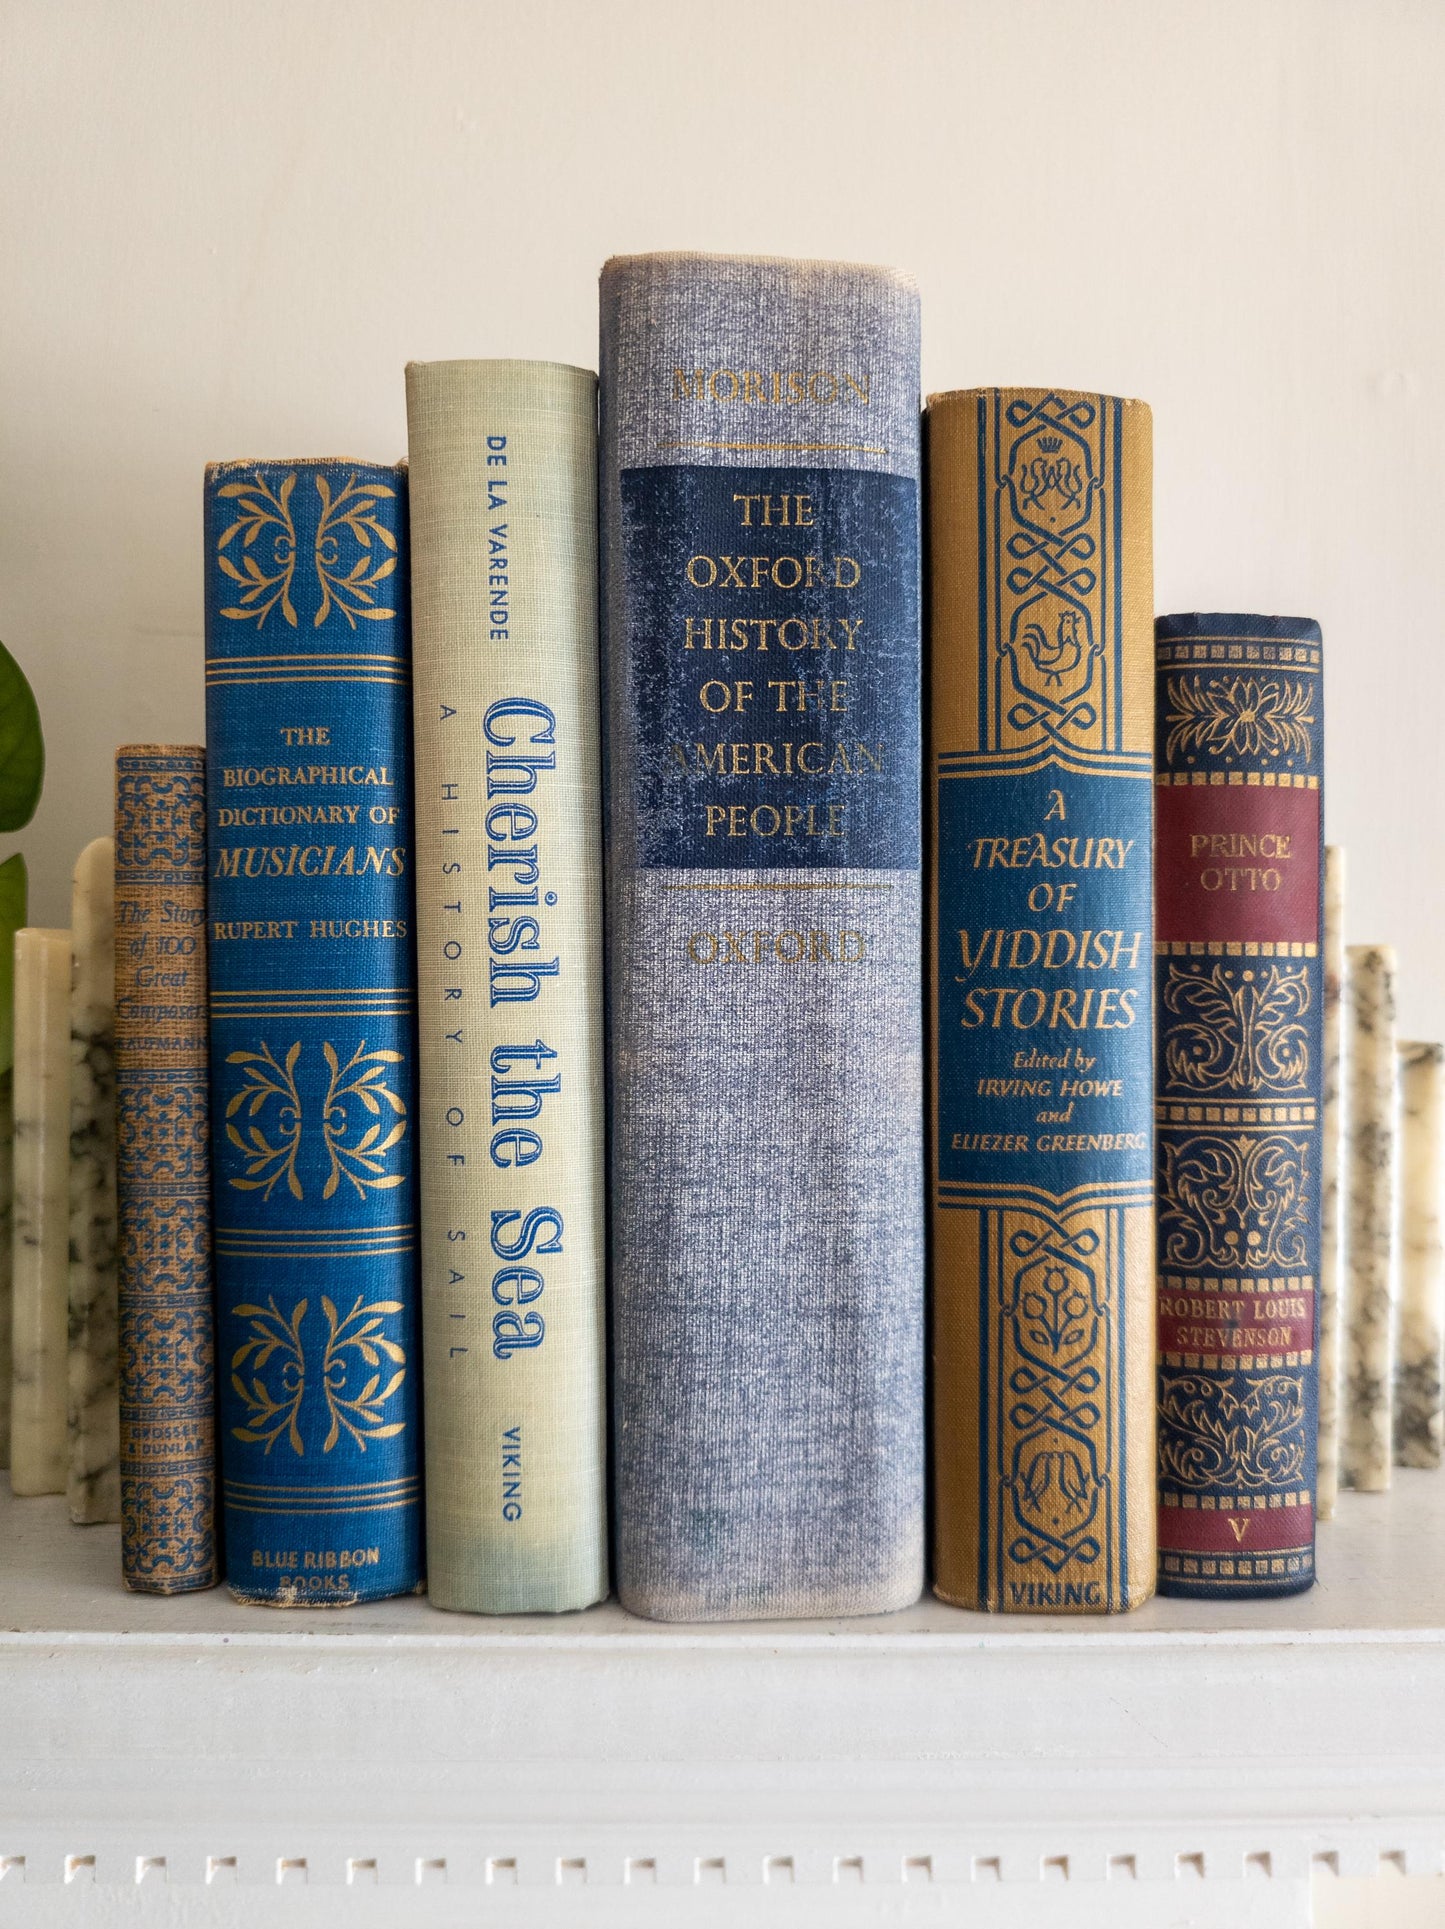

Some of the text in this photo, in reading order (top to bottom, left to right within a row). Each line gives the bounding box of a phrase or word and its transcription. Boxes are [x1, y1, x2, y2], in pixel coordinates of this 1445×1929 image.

[672, 368, 871, 405] MORISON
[733, 494, 815, 526] THE
[486, 435, 509, 640] DE LA VARENDE
[686, 555, 862, 589] OXFORD
[683, 616, 864, 650] HISTORY
[699, 679, 849, 713] OF THE
[280, 726, 331, 746] THE
[669, 741, 885, 775] AMERICAN
[222, 766, 395, 788] BIOGRAPHICAL
[218, 805, 400, 827] DICTIONARY OF
[704, 804, 846, 837] PEOPLE
[1043, 789, 1067, 822] A
[213, 845, 407, 878] MUSICIANS
[967, 831, 1135, 869] TREASURY
[1189, 833, 1292, 859] PRINCE
[1200, 868, 1282, 892] OTTO
[1028, 882, 1078, 913] OF
[119, 899, 207, 928] The Story
[213, 919, 408, 940] RUPERT HUGHES
[129, 931, 197, 962] of 100
[686, 928, 867, 965] OXFORD
[954, 928, 1143, 983] YIDDISH
[135, 964, 189, 988] Great
[960, 987, 1139, 1030] STORIES
[439, 704, 468, 1358] A HISTORY OF SAIL
[482, 696, 564, 1360] Cherish the Sea
[1013, 1047, 1098, 1074] Edited by
[977, 1078, 1124, 1097] IRVING HOWE
[1035, 1101, 1075, 1124] and
[952, 1132, 1147, 1152] ELIEZER GREENBERG
[1160, 1297, 1306, 1320] ROBERT LOUIS
[1176, 1326, 1292, 1348] STEVENSON
[501, 1426, 523, 1522] VIKING
[1227, 1516, 1250, 1543] V
[252, 1546, 381, 1569] BLUE RIBBON
[279, 1573, 350, 1592] BOOKS
[1009, 1580, 1101, 1606] VIKING
